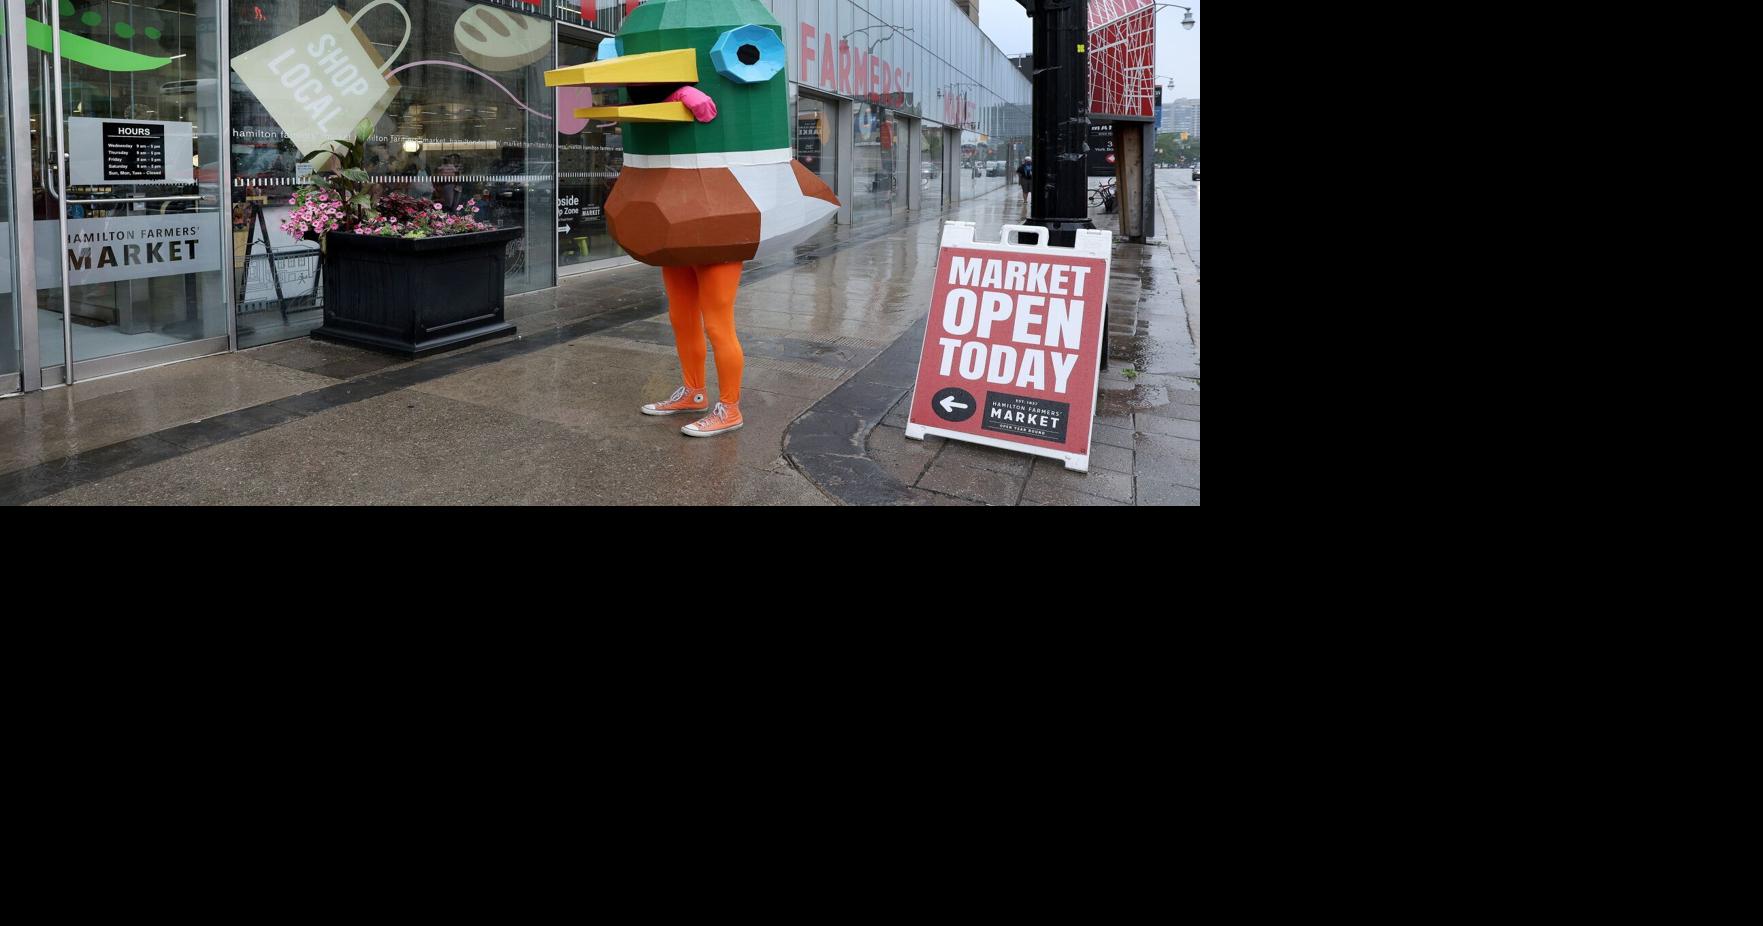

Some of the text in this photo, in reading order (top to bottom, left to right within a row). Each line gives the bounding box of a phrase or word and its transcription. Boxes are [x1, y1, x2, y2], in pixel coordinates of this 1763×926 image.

[307, 34, 368, 96] SHOP
[268, 48, 342, 132] LOCAL
[233, 128, 277, 138] hamilton
[141, 227, 200, 239] FARMERS'
[68, 239, 199, 271] MARKET
[949, 256, 1091, 297] MARKET
[942, 288, 1084, 350] OPEN
[939, 337, 1078, 394] TODAY
[990, 408, 1060, 428] MARKET
[992, 401, 1062, 416] HAMILTON FARMERS'
